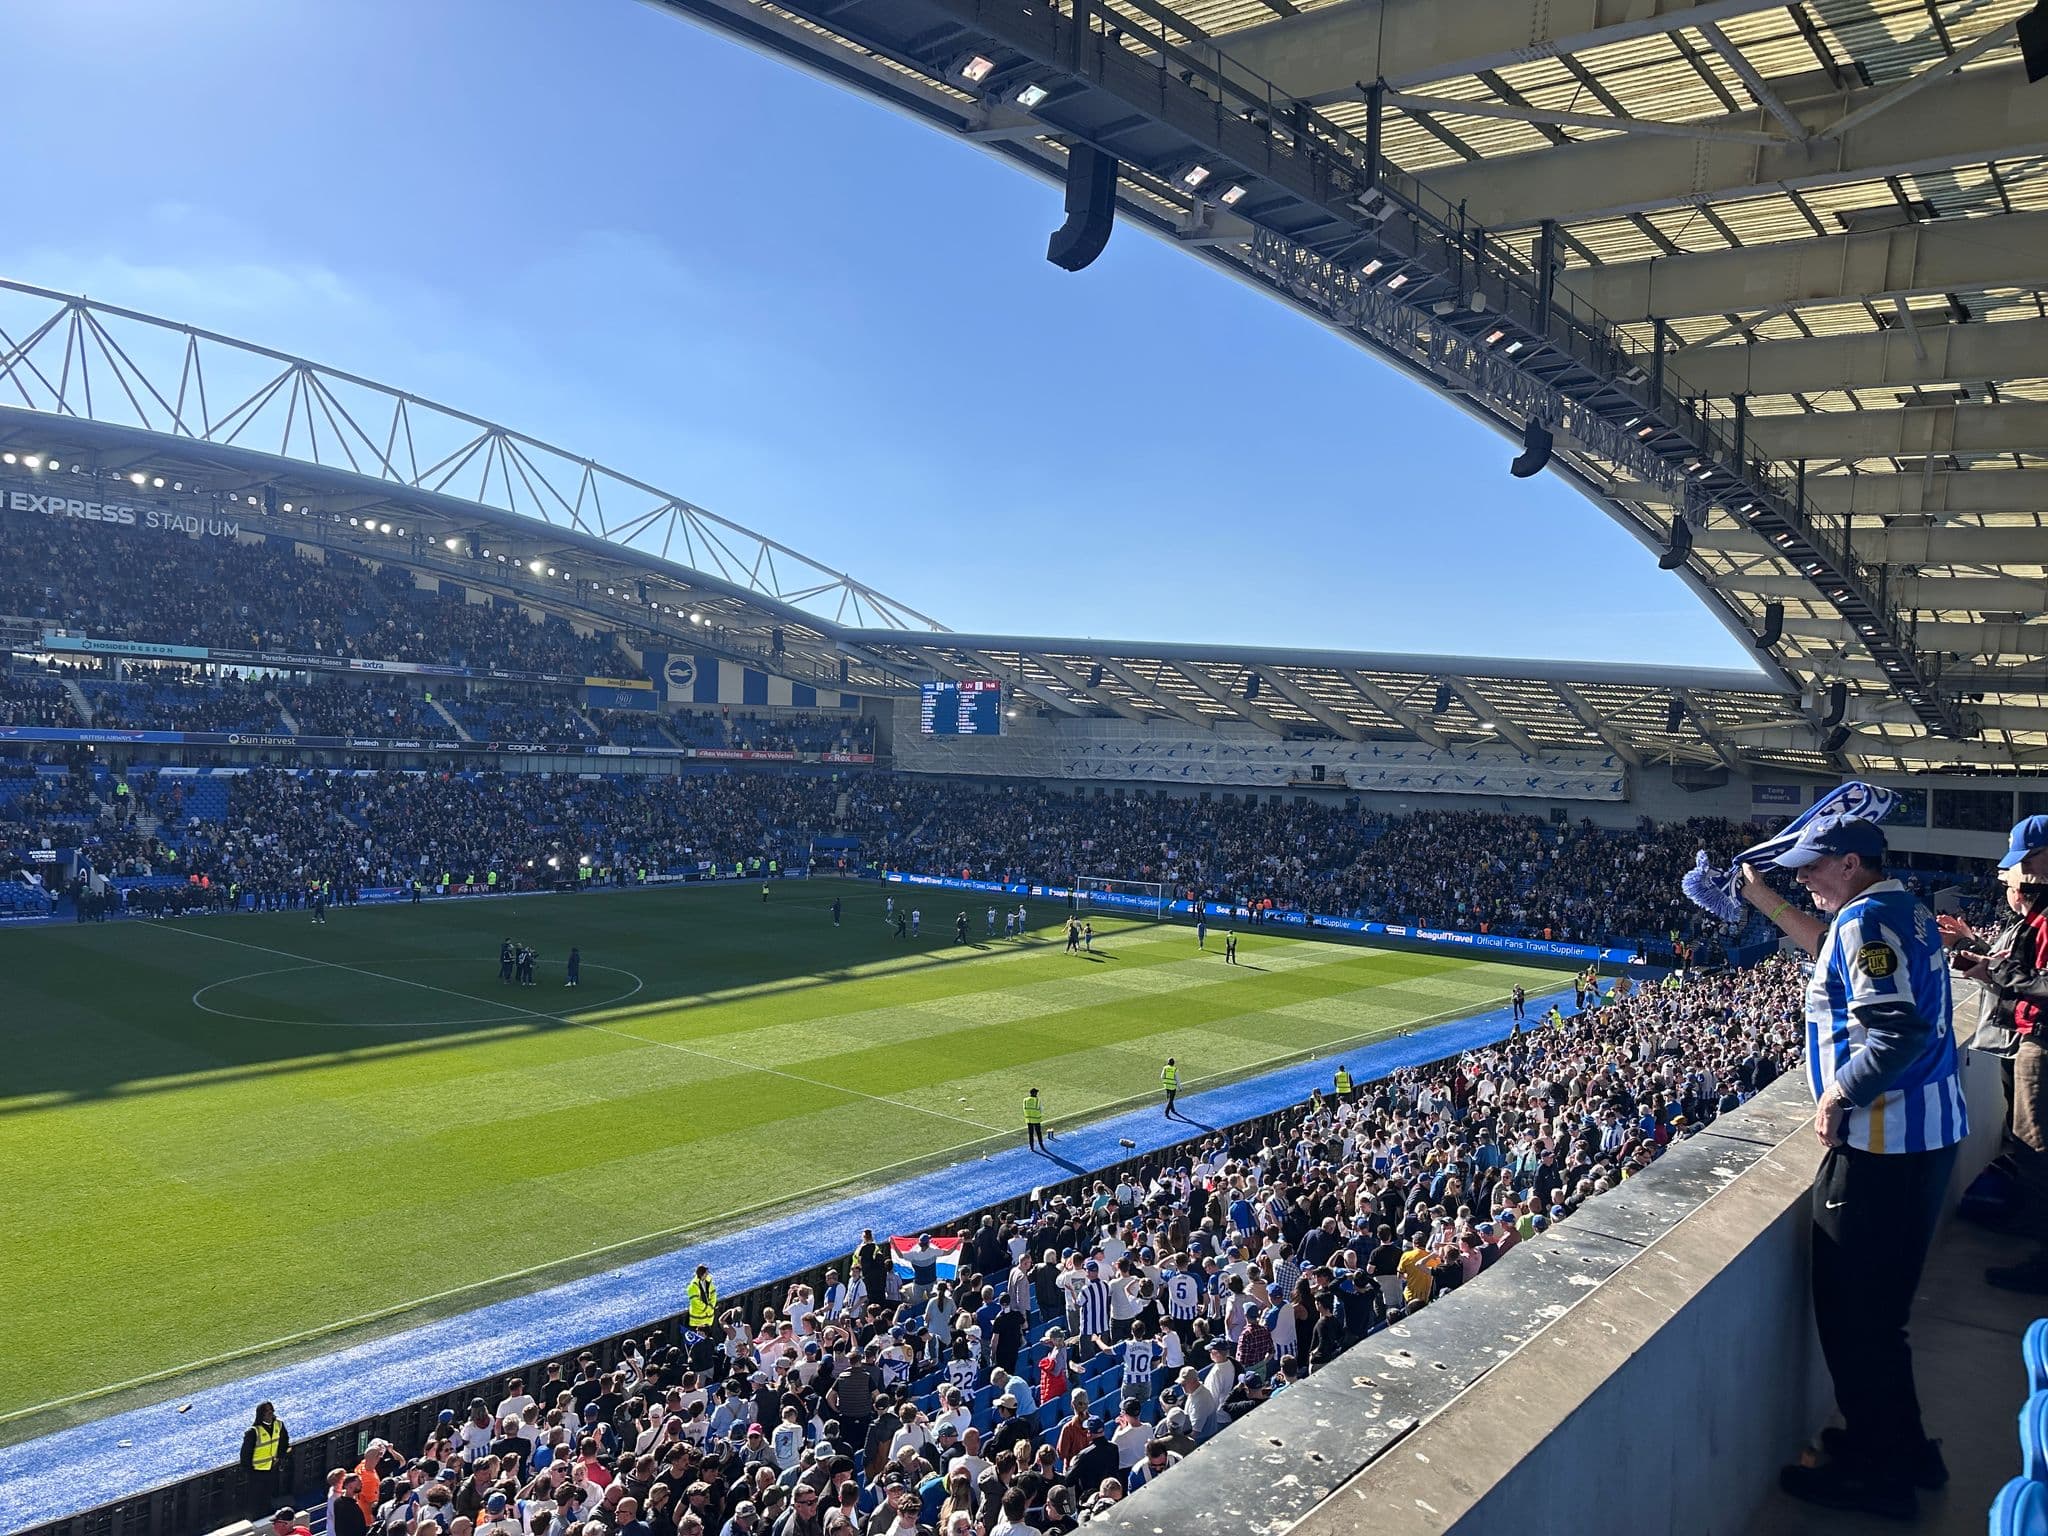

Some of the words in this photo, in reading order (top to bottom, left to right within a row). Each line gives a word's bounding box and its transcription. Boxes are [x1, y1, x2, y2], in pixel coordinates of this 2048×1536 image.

[11, 491, 135, 525] EXPRESS
[146, 511, 239, 538] STADIUM
[93, 642, 128, 651] HOSIDEN
[262, 654, 286, 662] Porsche
[240, 735, 258, 744] Sun
[260, 736, 296, 745] Harvest
[834, 754, 851, 762] Rex
[1476, 936, 1502, 947] Official
[1505, 940, 1523, 949] Fans
[1526, 941, 1549, 952] Travel
[1551, 945, 1584, 955] Supplier
[1870, 956, 1886, 969] UK
[1176, 1282, 1187, 1300] 5
[1130, 1354, 1149, 1373] 10
[953, 1371, 974, 1390] 22
